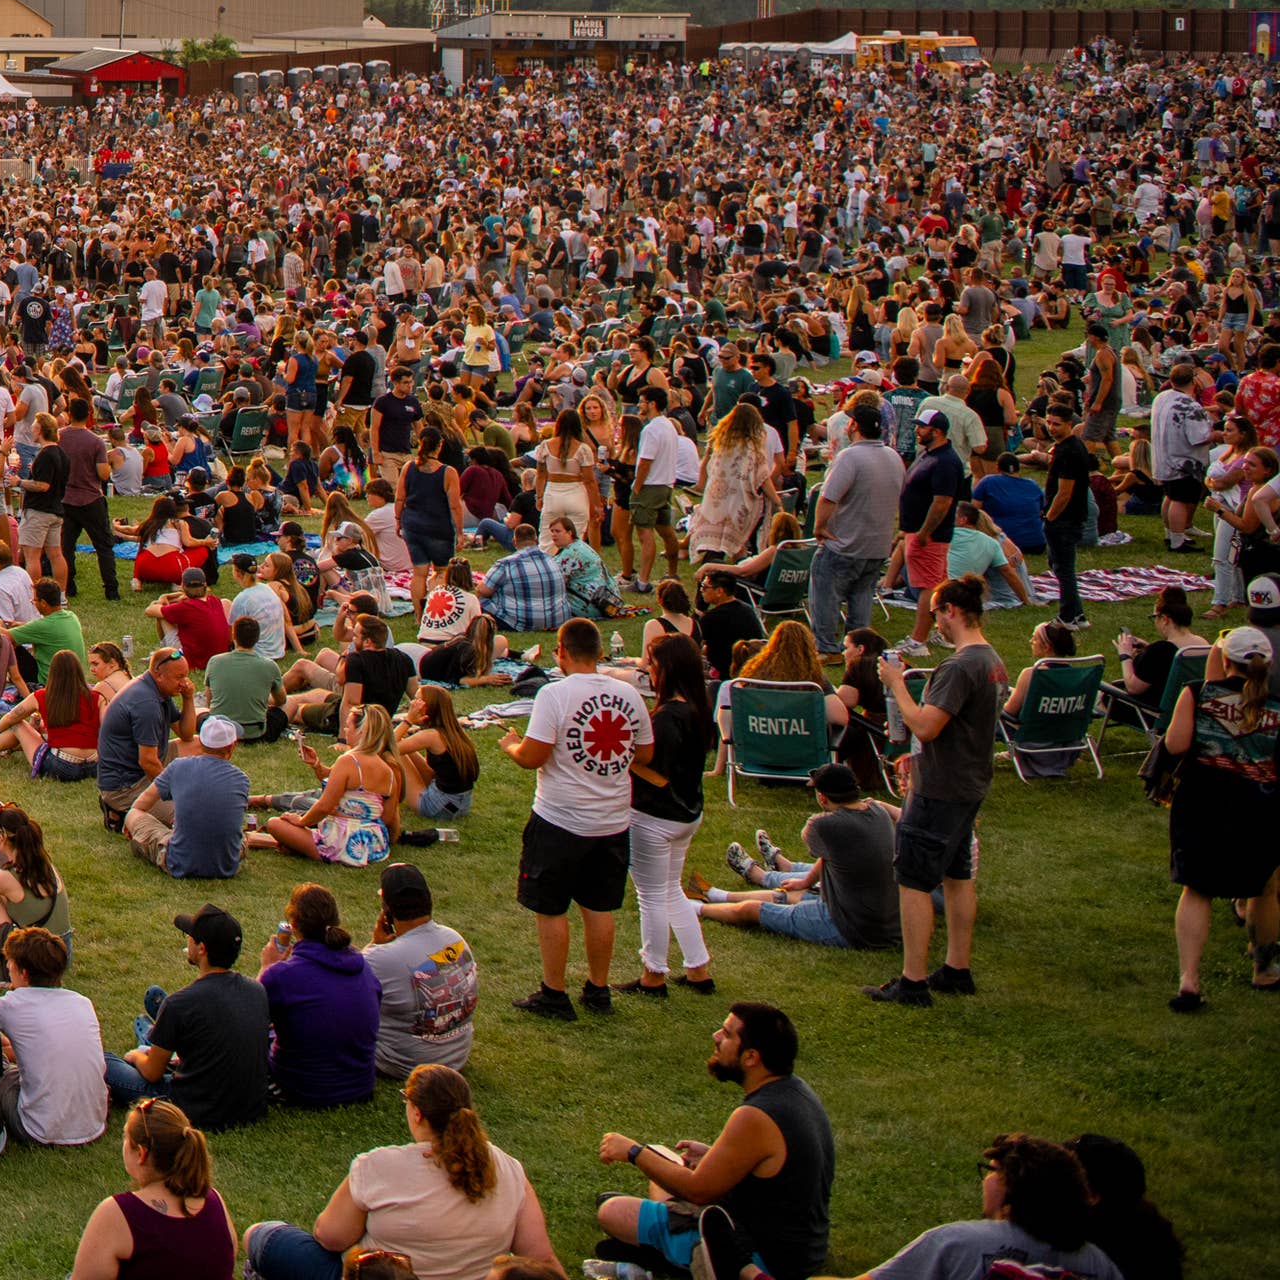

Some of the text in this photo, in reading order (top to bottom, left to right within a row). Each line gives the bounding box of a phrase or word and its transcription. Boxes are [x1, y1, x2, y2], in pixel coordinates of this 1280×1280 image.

[573, 20, 604, 28] BARREL
[778, 569, 809, 583] RENTA
[572, 694, 640, 726] HOT CHILI
[1038, 694, 1086, 714] RENTAL
[748, 715, 810, 736] RENTAL
[566, 727, 588, 764] RED
